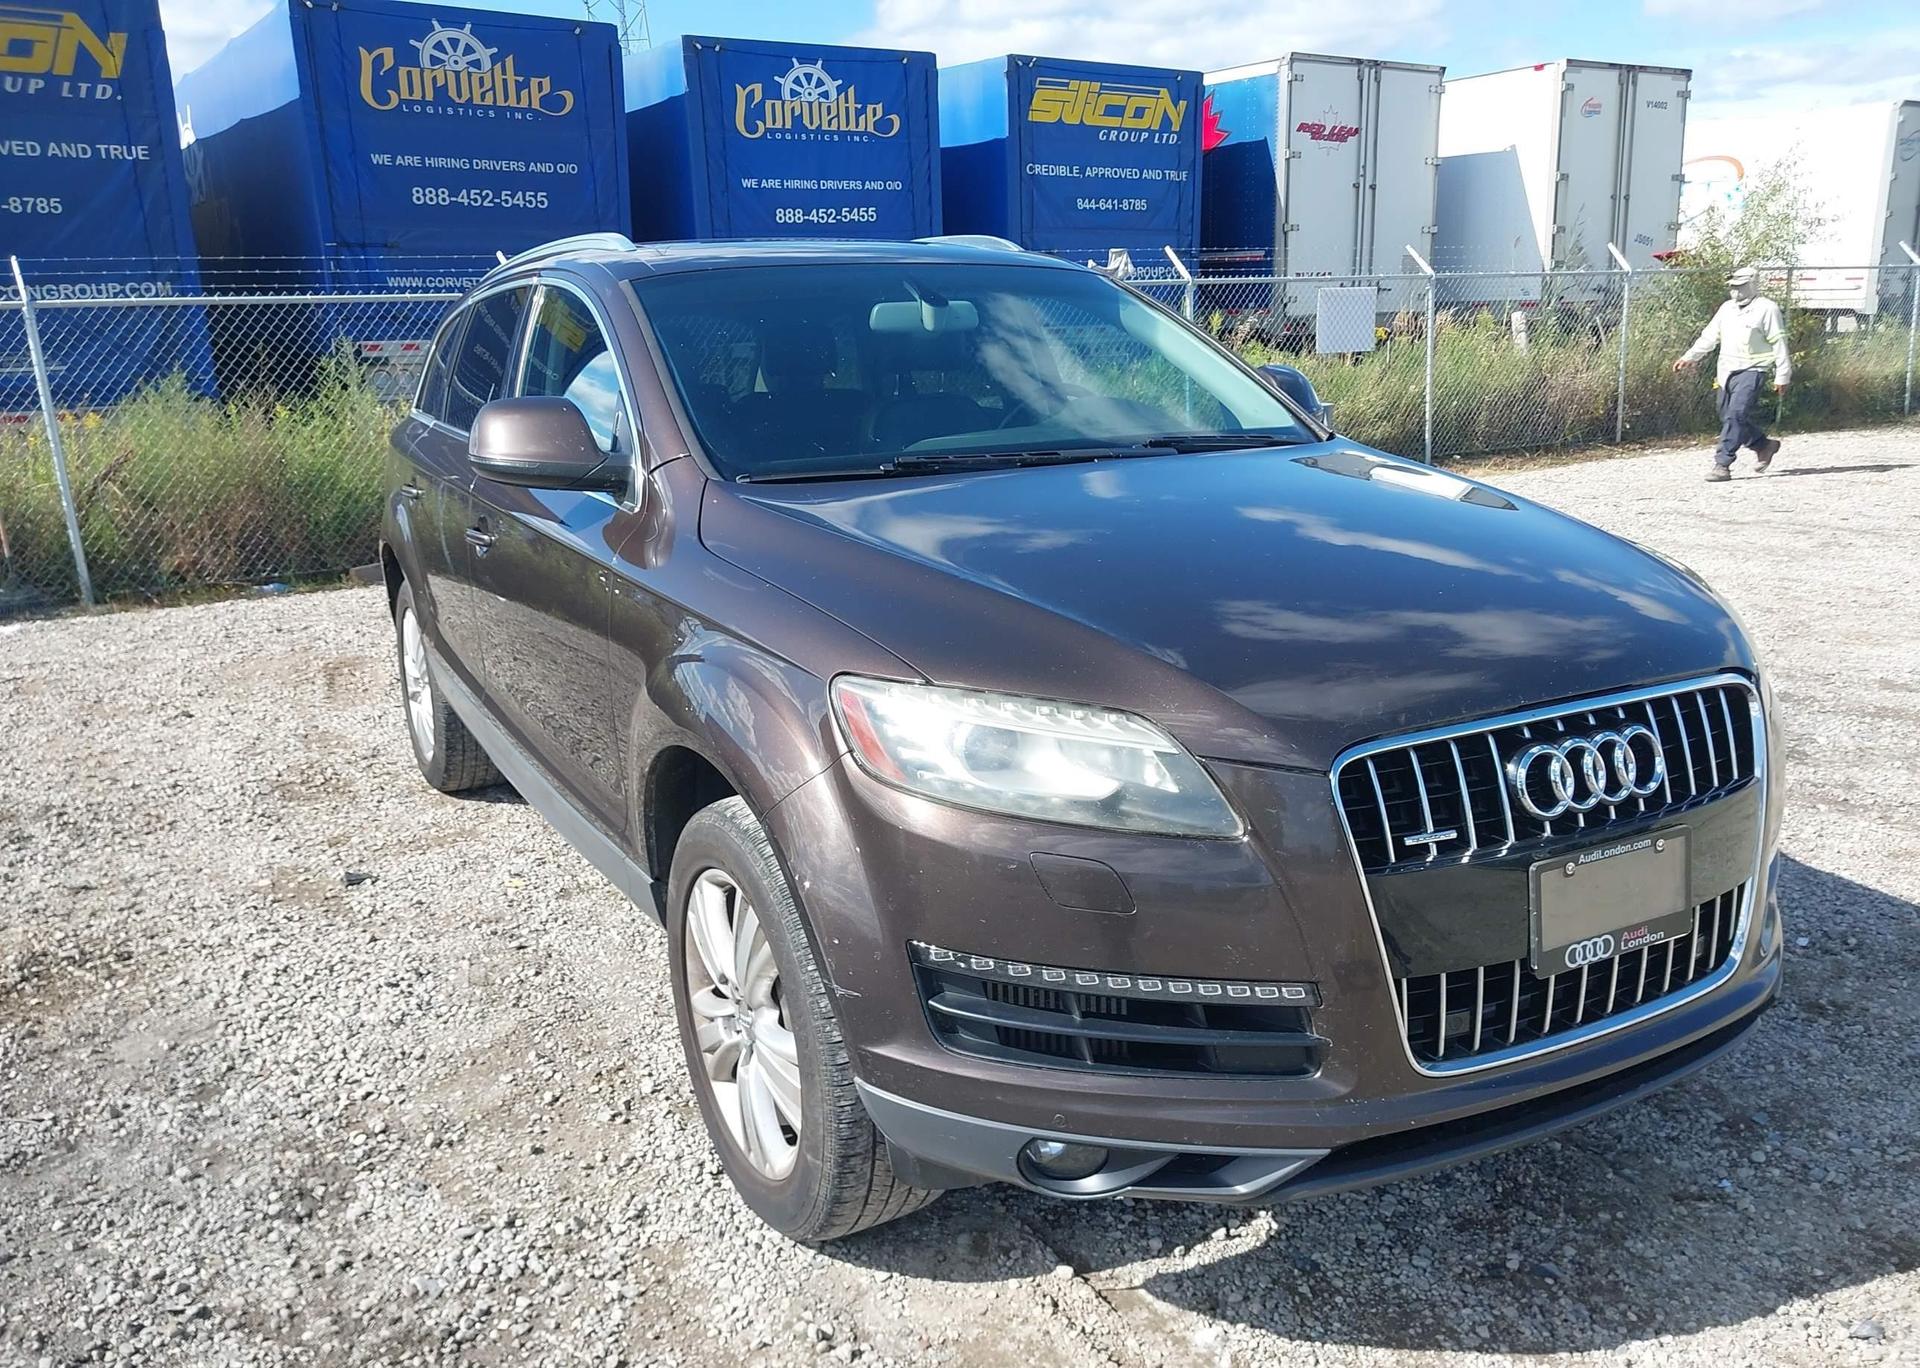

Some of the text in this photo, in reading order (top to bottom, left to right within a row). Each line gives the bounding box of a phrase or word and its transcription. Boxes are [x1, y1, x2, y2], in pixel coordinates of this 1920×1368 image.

[4, 76, 122, 101] UP LTD.
[358, 46, 575, 116] Corvette
[402, 104, 542, 121] LOGISTICS INC.
[735, 83, 901, 138] Corvette
[766, 132, 876, 143] LOGISTICS INC.
[1099, 129, 1182, 145] GROUP LTD.
[47, 142, 92, 159] AND
[95, 144, 151, 160] TRUE
[370, 153, 578, 175] WE ARE HIRING DRIVERS AND O/O
[1026, 163, 1189, 182] CREDIBLE, APPROVED AND TRUE
[741, 178, 903, 191] WE ARE HIRING DRIVERS AND O/O
[411, 187, 549, 209] 888-452-5455
[1076, 197, 1148, 211] 844-641-8785
[775, 207, 877, 224] 888-452-5455
[1578, 839, 1652, 864] AudiLondon.com
[1620, 925, 1648, 941] Audi
[1620, 930, 1665, 951] London
